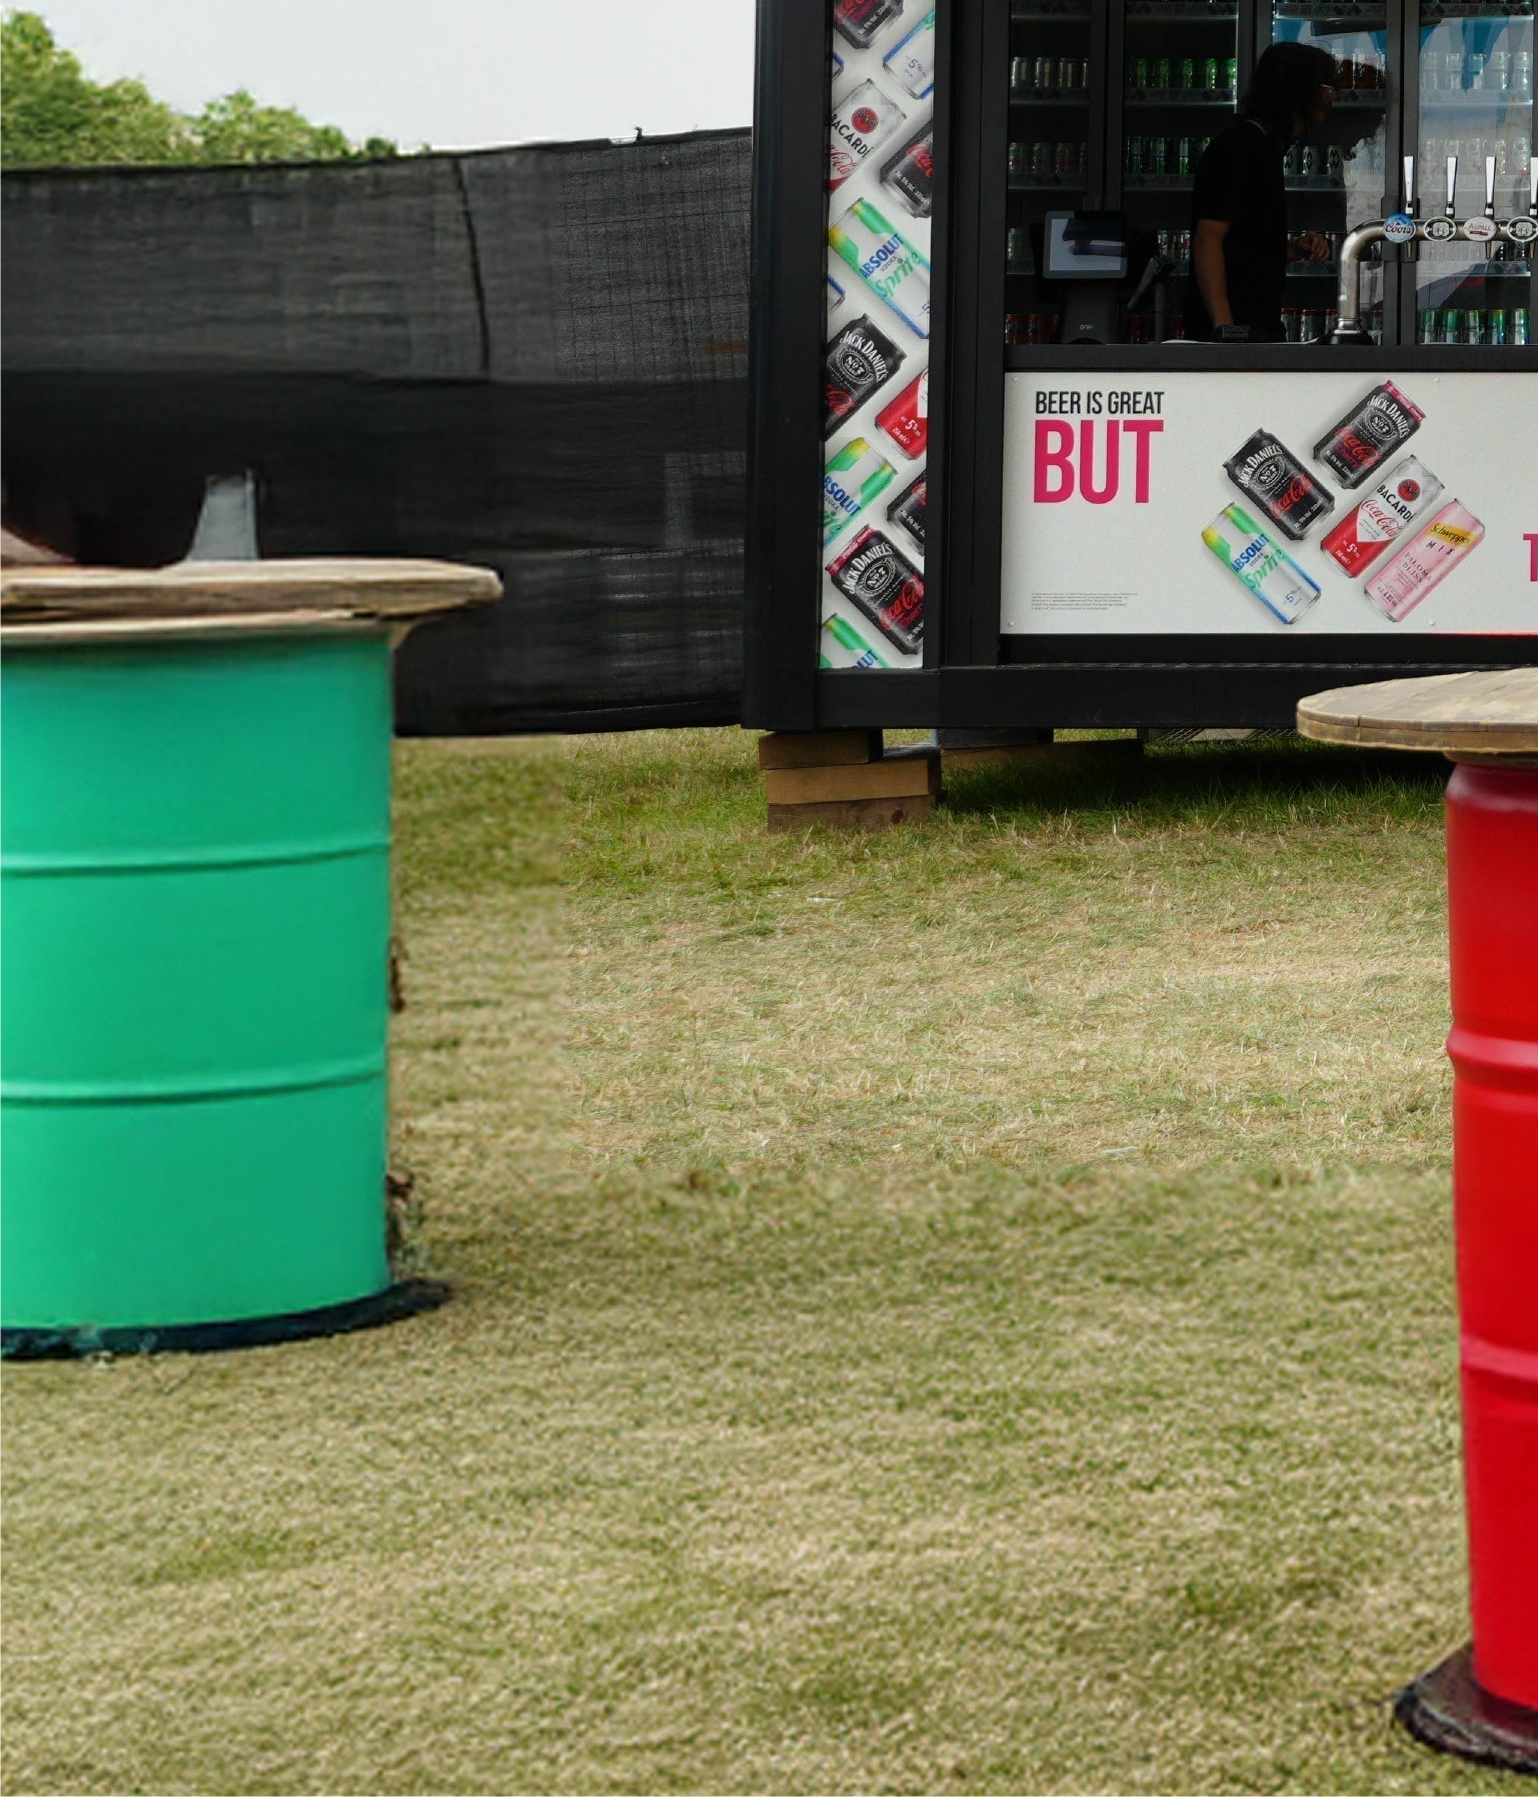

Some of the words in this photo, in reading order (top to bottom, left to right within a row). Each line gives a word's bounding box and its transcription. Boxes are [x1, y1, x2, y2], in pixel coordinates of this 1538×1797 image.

[1385, 223, 1412, 235] Coors
[859, 232, 904, 280] ABSOLUT
[874, 252, 923, 298] Sprite
[839, 330, 866, 348] JACK
[861, 340, 889, 383] DANIEL'S
[1035, 391, 1082, 415] BEER
[1086, 391, 1103, 415] IS
[1107, 391, 1165, 415] GREAT
[1367, 394, 1389, 414] JACK
[1388, 403, 1413, 439] DANIEL'S
[1033, 419, 1165, 505] BUT
[1237, 460, 1254, 489] JACK
[1246, 445, 1284, 471] DANIEL'S
[824, 474, 862, 516] BSOLUT
[1360, 498, 1404, 539] Coca-Cola
[1429, 522, 1471, 547] Schweppes
[842, 572, 858, 596] JACK
[852, 542, 894, 576] DANIEL'S
[1231, 532, 1271, 574] ABSOLUT
[1244, 548, 1289, 590] Sprite
[1400, 560, 1424, 585] BLISS
